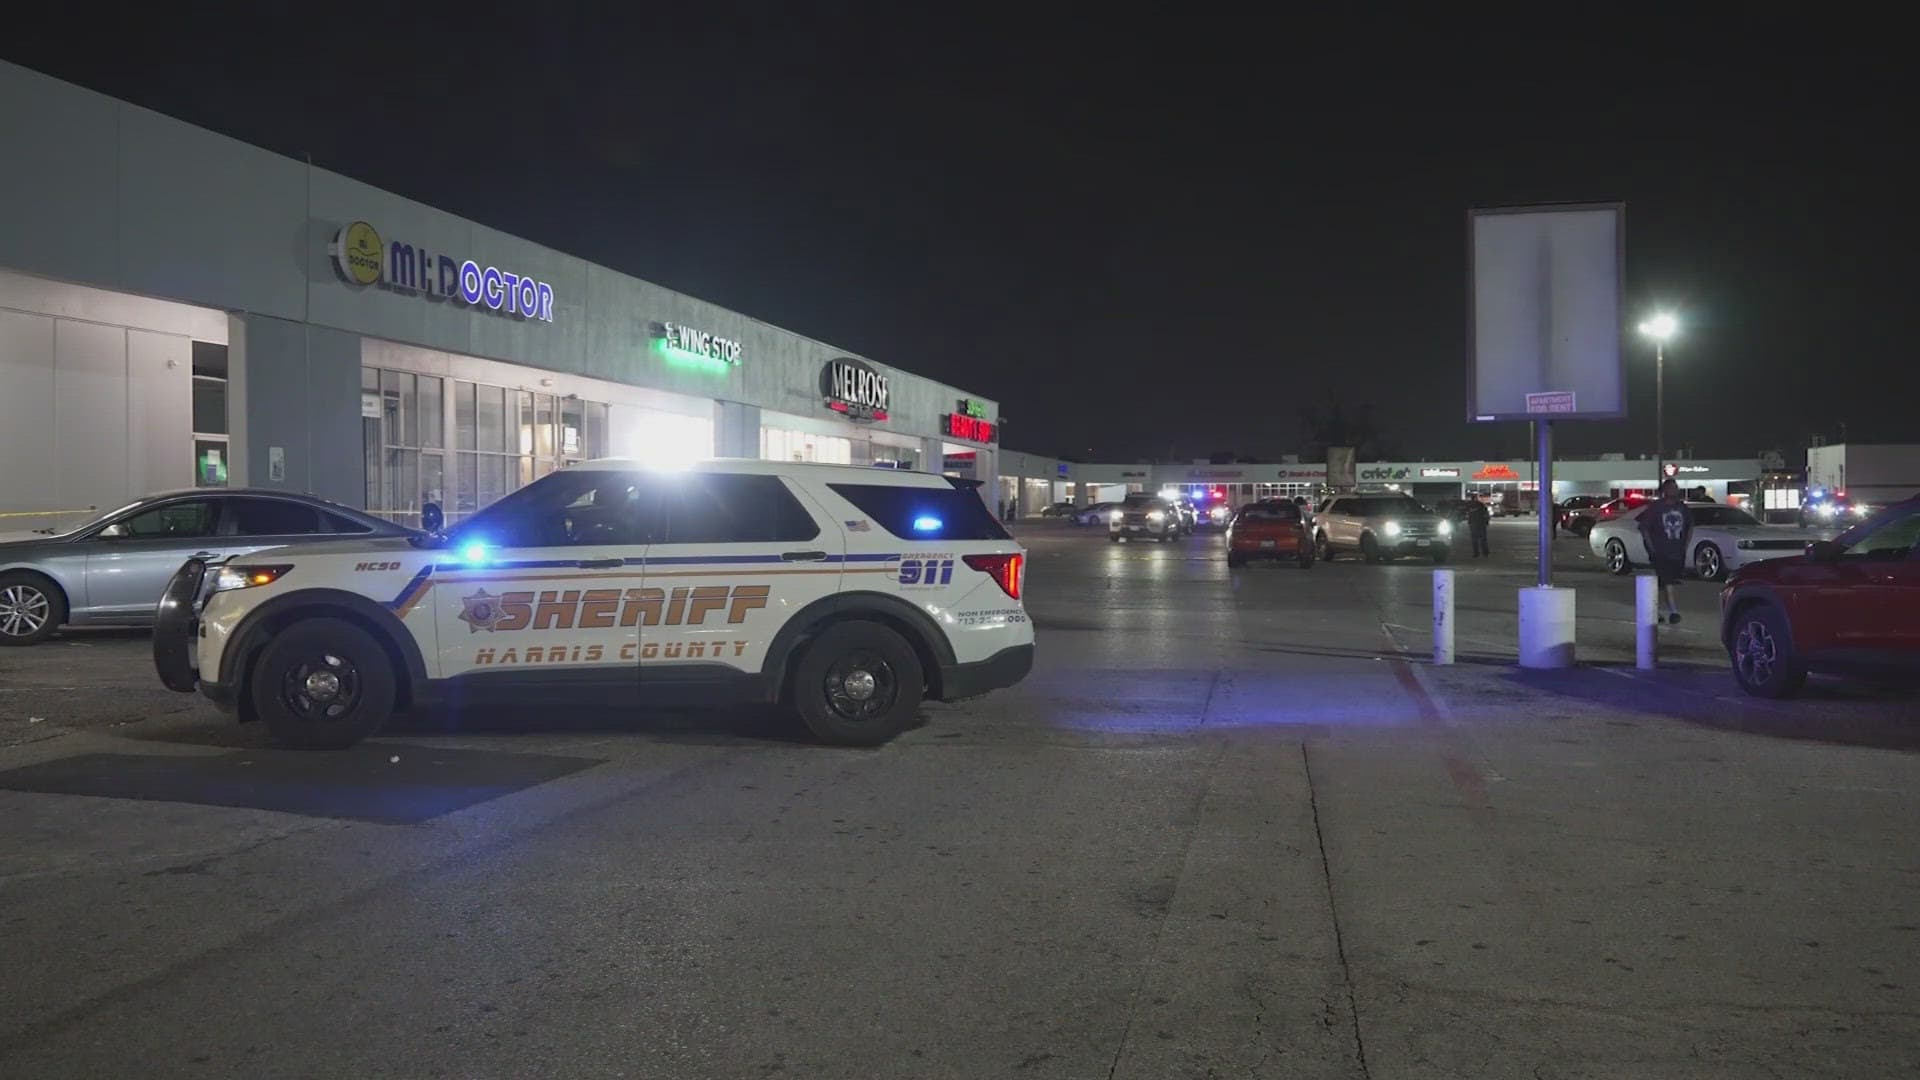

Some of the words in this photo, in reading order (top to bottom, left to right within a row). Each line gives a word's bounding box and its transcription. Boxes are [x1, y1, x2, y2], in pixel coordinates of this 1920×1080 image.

[678, 325, 710, 359] WING
[712, 336, 742, 365] STOP
[831, 360, 889, 410] MELROSE
[902, 552, 953, 560] EMERGENCY
[898, 559, 954, 585] 911
[495, 585, 770, 631] SHERIFF
[958, 610, 978, 618] NON
[475, 645, 603, 666] HARRIS
[619, 641, 748, 661] COUNTY
